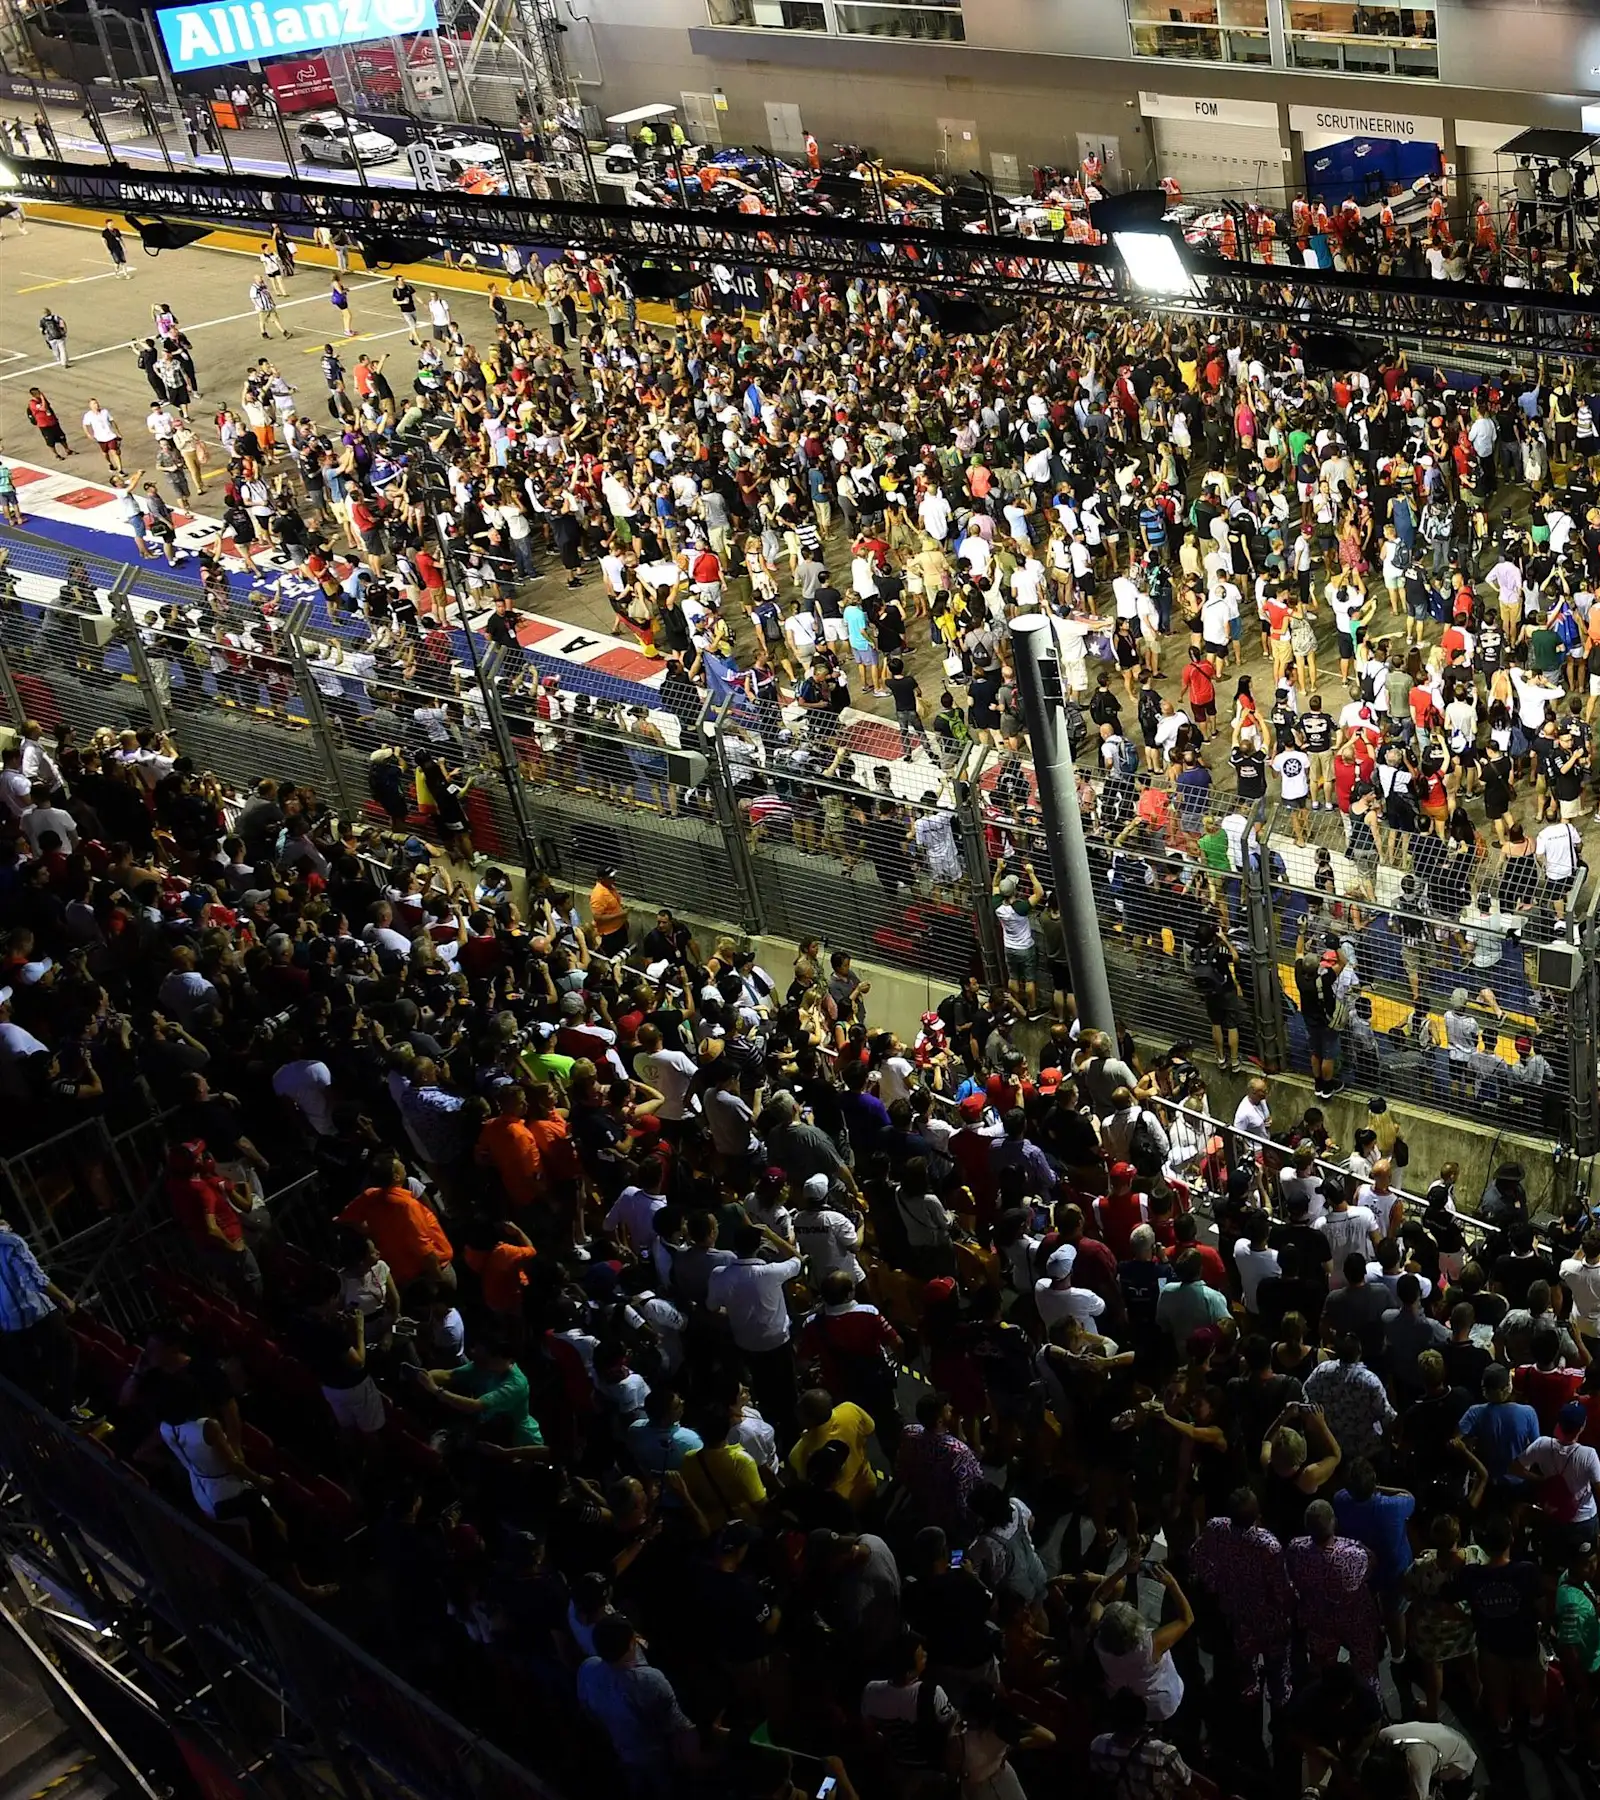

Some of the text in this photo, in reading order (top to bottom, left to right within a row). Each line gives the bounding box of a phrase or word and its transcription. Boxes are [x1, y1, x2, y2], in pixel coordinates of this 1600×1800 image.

[176, 0, 368, 61] Allianz
[1195, 102, 1218, 116] FOM
[1317, 114, 1414, 135] SCRUTINEERING
